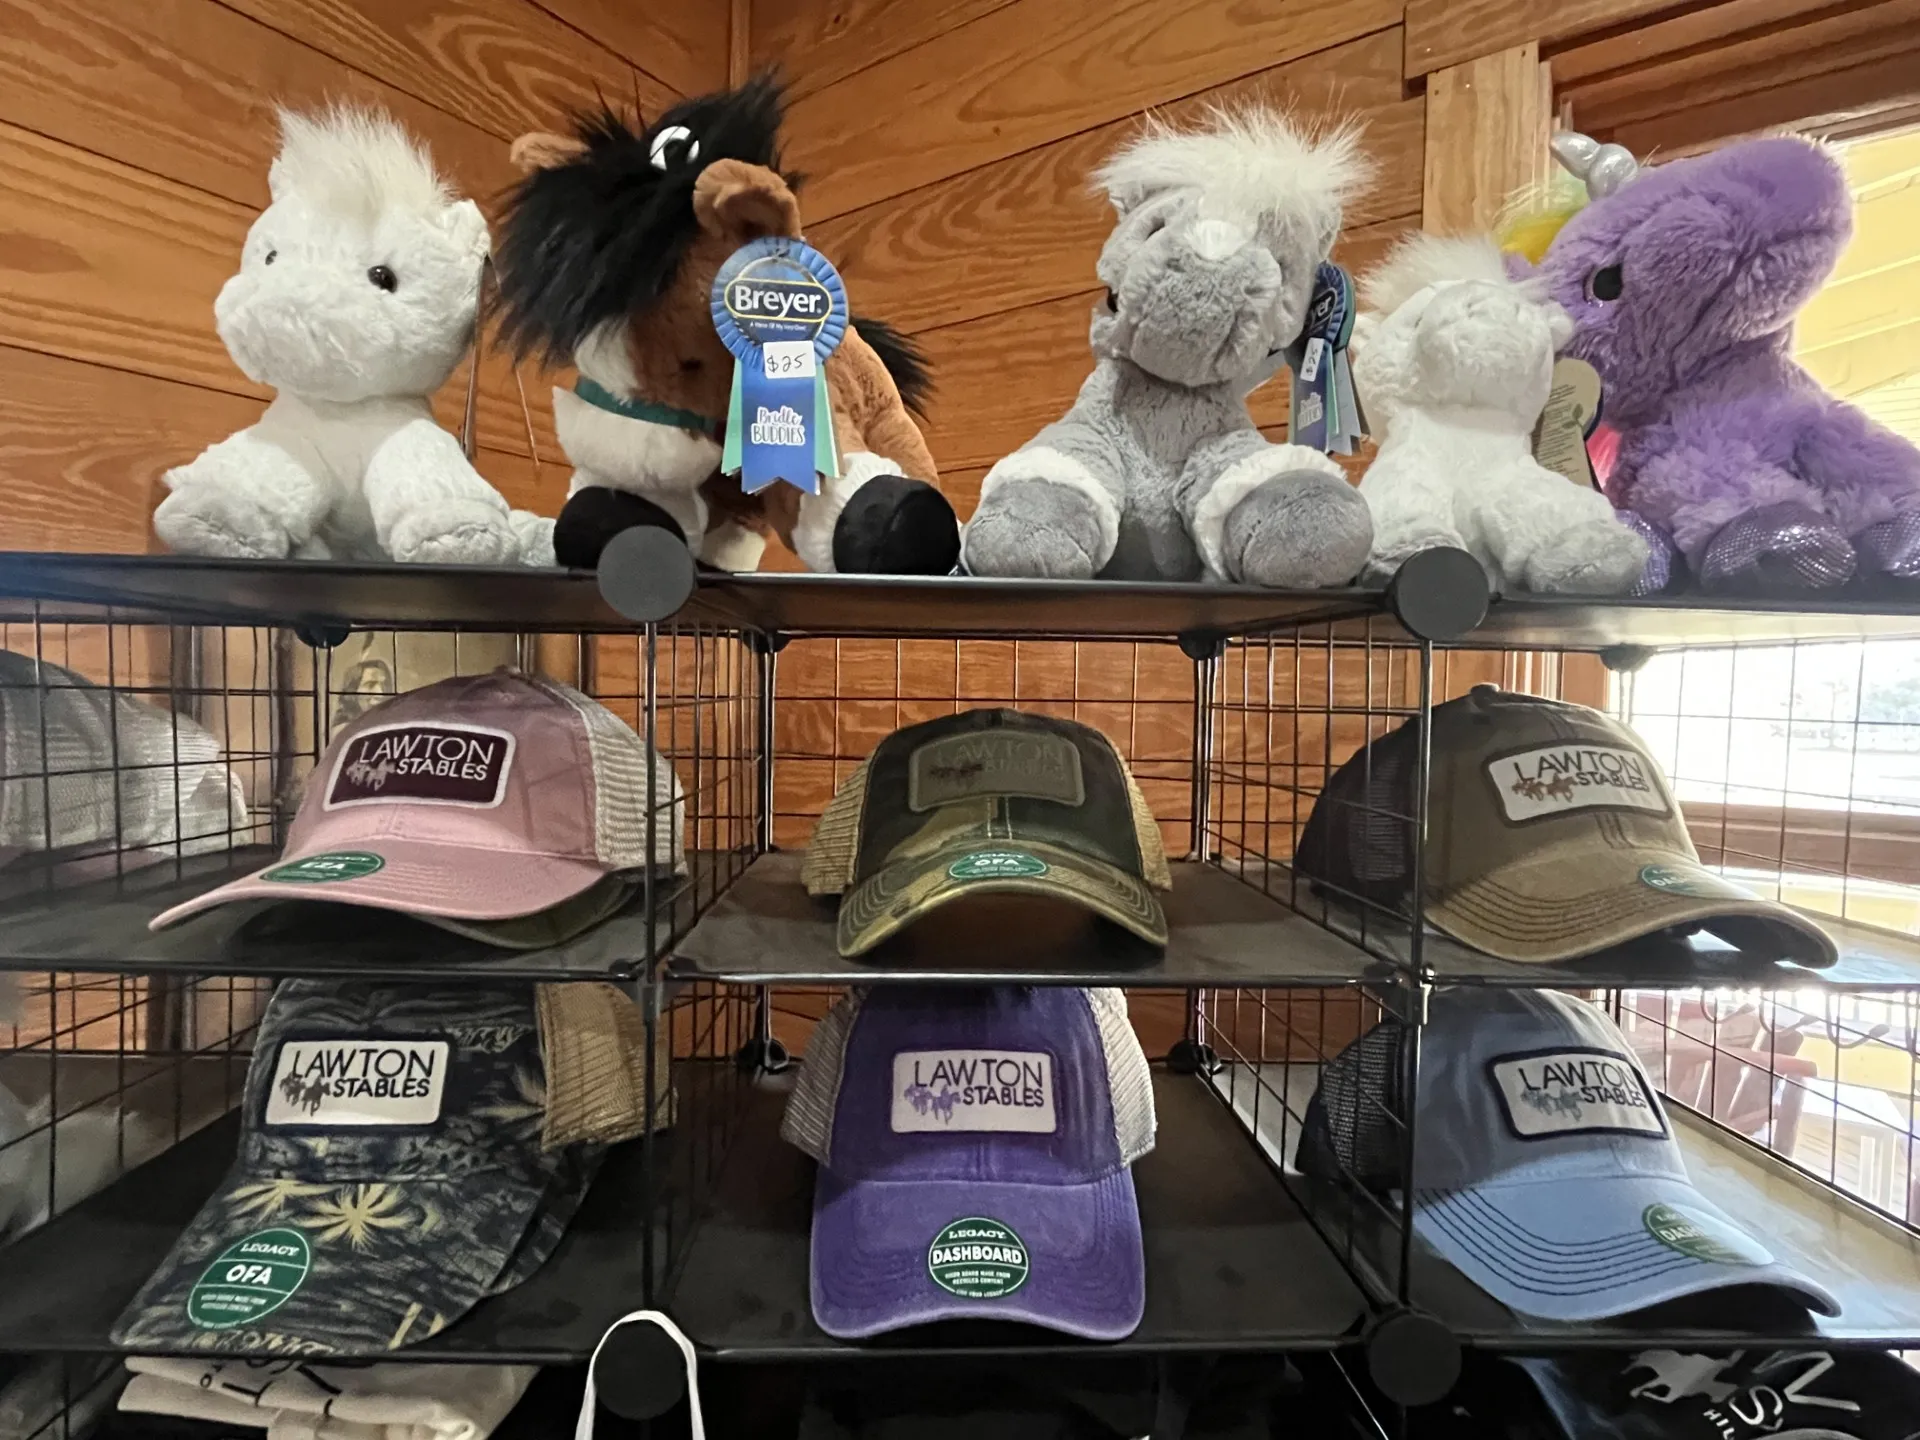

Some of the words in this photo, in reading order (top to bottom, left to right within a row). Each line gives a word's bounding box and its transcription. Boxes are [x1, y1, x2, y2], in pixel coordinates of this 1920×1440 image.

[734, 285, 822, 317] Breyer
[766, 352, 807, 373] $25
[758, 406, 803, 424] Bridle
[753, 424, 805, 444] BUDDIES
[359, 734, 495, 765] LAWTON
[396, 758, 489, 781] STABLES
[1513, 750, 1645, 780] LAWTON
[1575, 771, 1651, 793] STABLES
[974, 858, 1020, 866] OFA
[293, 1048, 435, 1078] LAWTON
[914, 1059, 1043, 1088] LAWTON
[1518, 1061, 1639, 1091] LAWTON
[332, 1078, 431, 1098] STABLES
[962, 1086, 1045, 1107] STABLES
[1581, 1086, 1648, 1109] STABLES
[948, 1229, 1005, 1239] LEGACY
[240, 1243, 300, 1256] LEGACY
[932, 1246, 1022, 1264] DASHBOARD
[226, 1264, 272, 1285] OFA
[1702, 1409, 1735, 1440] HIL
